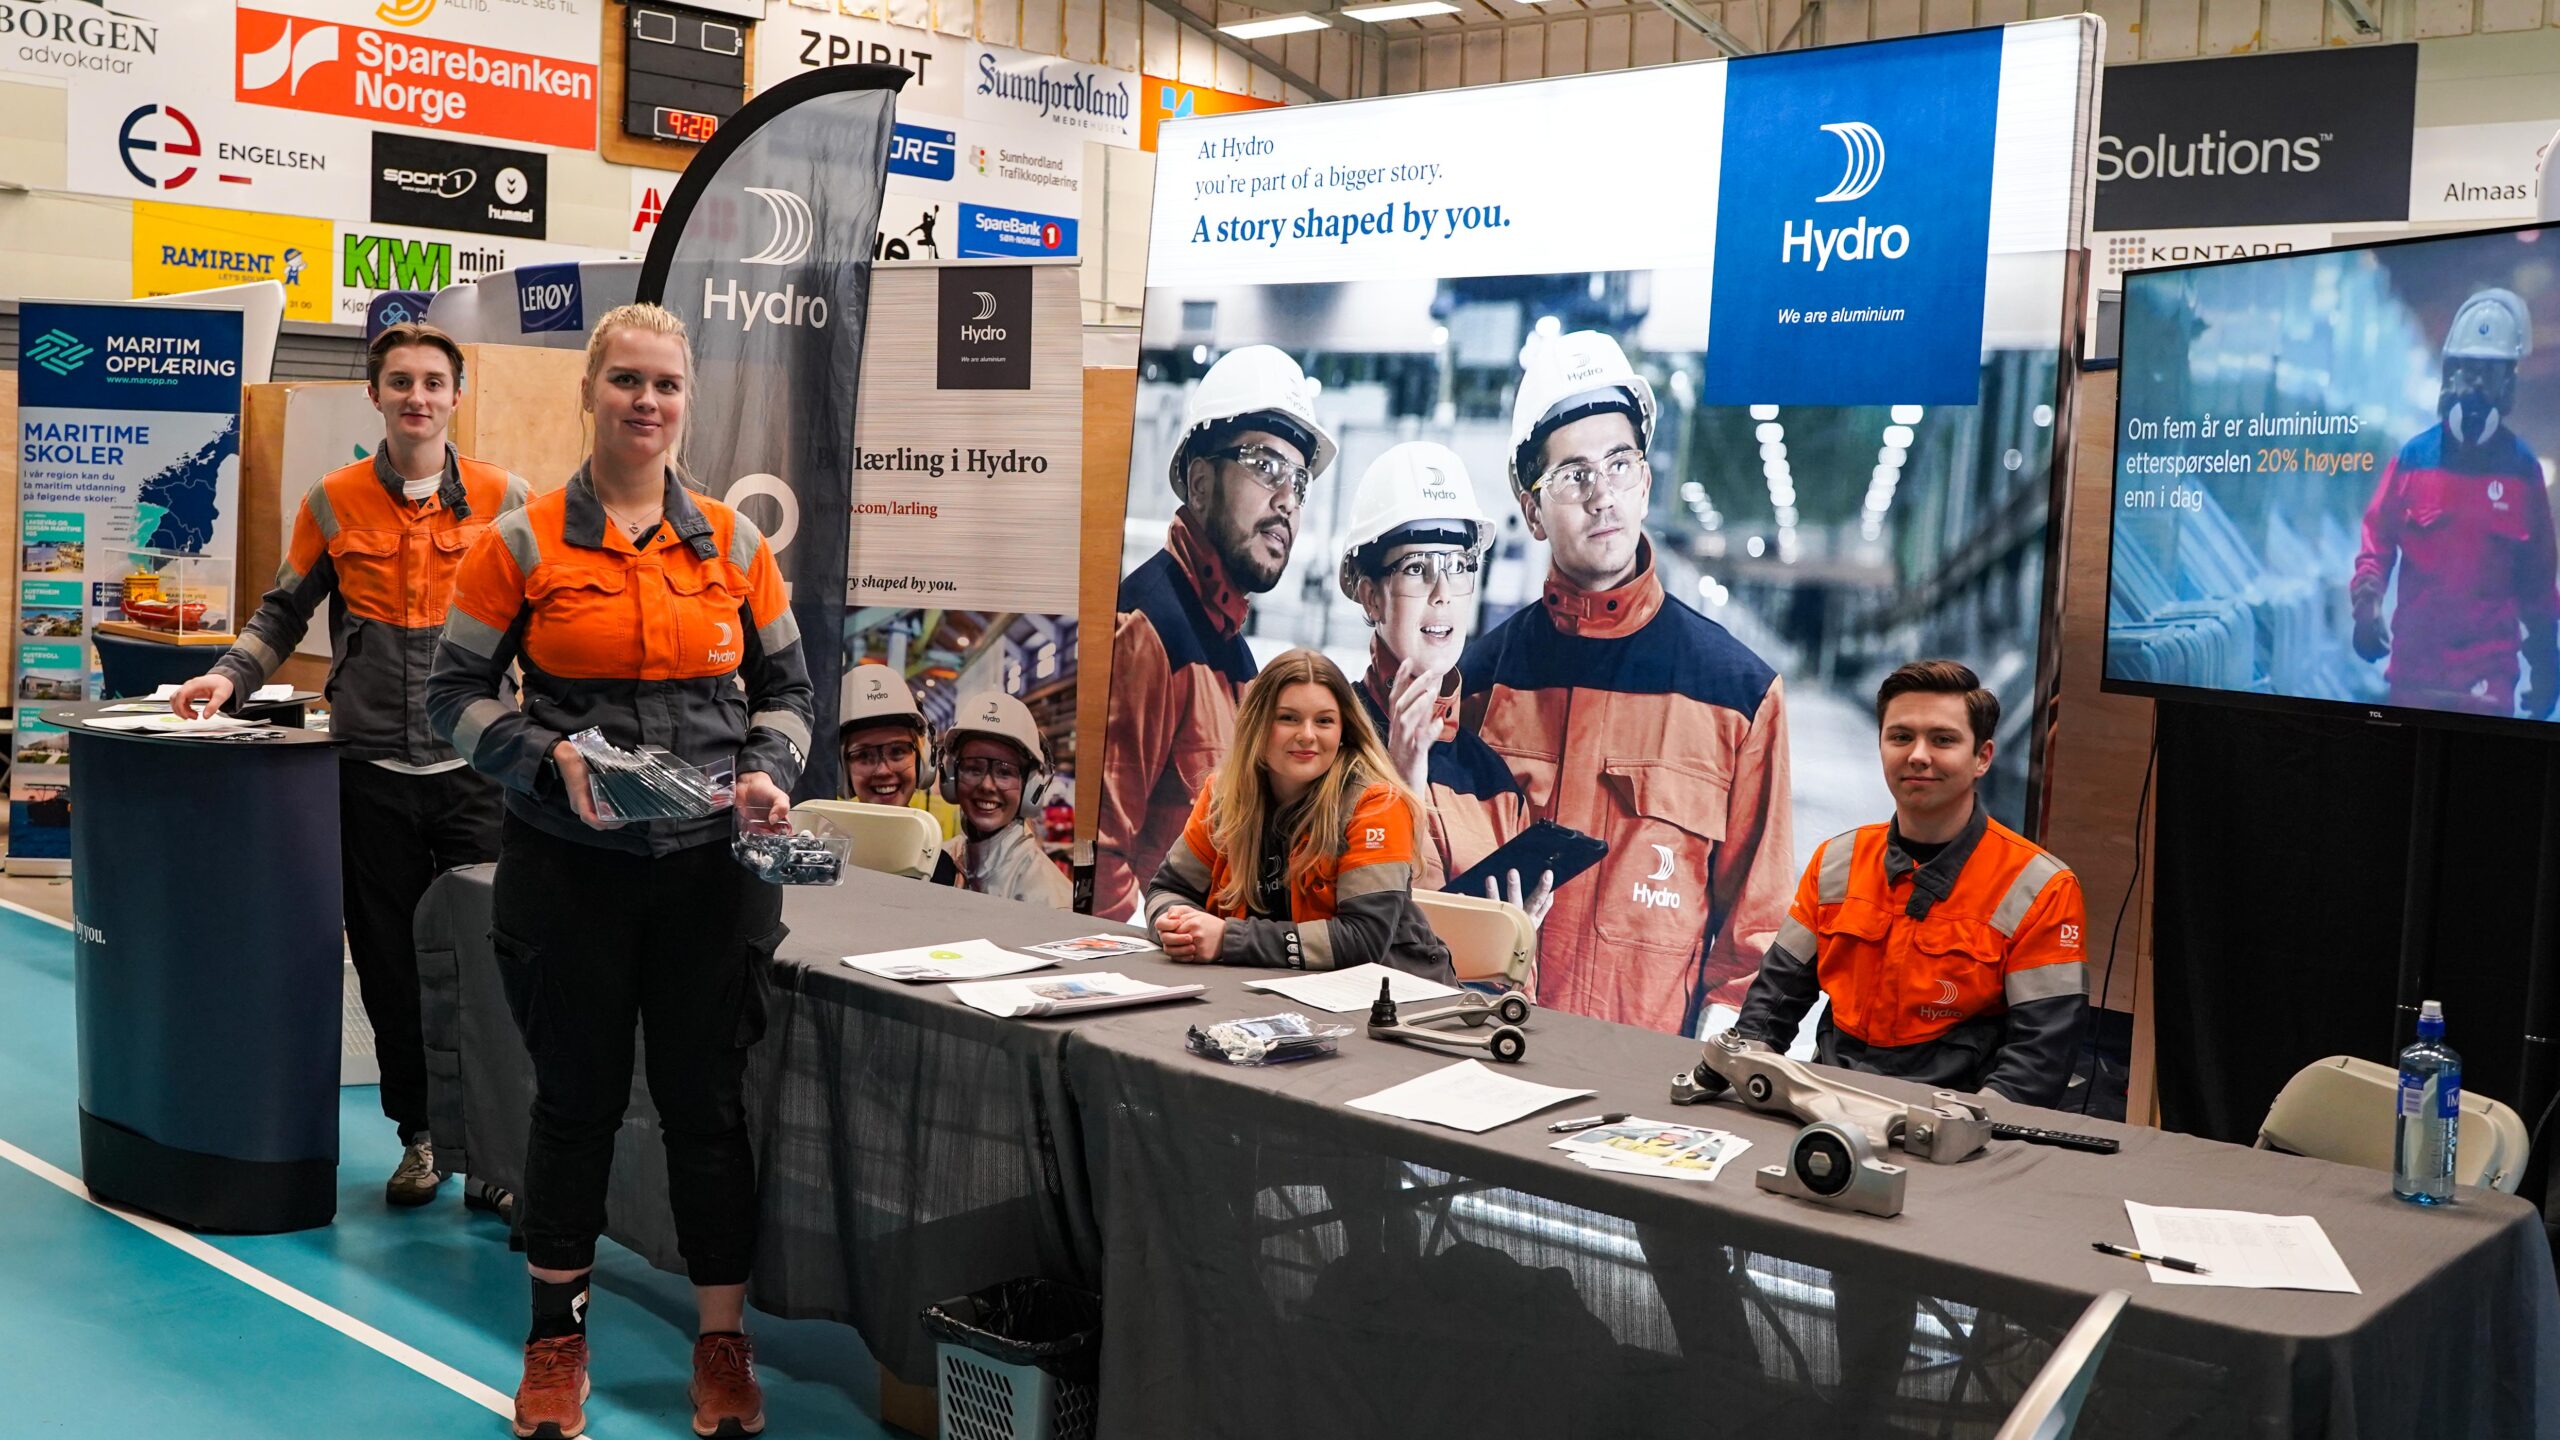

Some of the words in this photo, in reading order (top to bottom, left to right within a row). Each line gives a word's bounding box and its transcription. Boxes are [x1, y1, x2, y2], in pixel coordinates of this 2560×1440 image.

[19, 45, 134, 75] advokatar
[356, 30, 592, 100] Sparebanken
[355, 70, 466, 124] Norge
[977, 53, 1129, 120] Sunnhordland
[669, 112, 716, 141] 9:28
[219, 142, 326, 171] ENGELSEN
[1198, 139, 1217, 160] At
[1222, 135, 1275, 163] Hydro
[1000, 150, 1063, 170] Sunnhordland
[383, 168, 447, 186] sport
[1000, 166, 1078, 191] Trafikkopplæring
[1250, 171, 1286, 198] part
[1291, 167, 1312, 190] of
[1314, 172, 1324, 188] a
[1330, 166, 1386, 191] bigger
[1390, 161, 1442, 186] story.
[2443, 182, 2527, 202] Almaas
[488, 204, 534, 223] hummel
[975, 213, 1041, 236] SpareBank
[1192, 215, 1211, 243] A
[1216, 212, 1287, 248] story
[1293, 202, 1394, 245] shaped
[1403, 201, 1439, 241] by
[1444, 203, 1511, 239] you.
[1782, 216, 1910, 272] Hydro
[162, 245, 274, 274] RAMIRENT
[343, 233, 452, 292] KIWI
[459, 247, 504, 272] mini
[522, 283, 574, 312] LERØY
[703, 278, 828, 331] Hydro
[1778, 308, 1800, 324] We
[1804, 310, 1827, 323] are
[1831, 306, 1905, 323] aluminium
[961, 325, 1007, 344] Hydro
[107, 336, 200, 355] MARITIM
[106, 355, 236, 376] OPPLÆRING
[106, 375, 179, 387] www.maropp.no
[25, 423, 149, 444] MARITIME
[2128, 417, 2158, 441] Om
[2163, 415, 2196, 439] fem
[2201, 413, 2220, 438] år
[2225, 419, 2240, 438] er
[2248, 411, 2367, 438] aluminiums-
[24, 444, 124, 465] SKOLER
[854, 446, 945, 478] lærling
[952, 448, 960, 471] i
[967, 449, 1048, 479] Hydro
[2126, 449, 2251, 478] etterspørselen
[2257, 448, 2298, 474] 20%
[2304, 448, 2374, 479] høyere
[24, 471, 27, 479] I
[29, 470, 45, 479] vår
[46, 471, 79, 481] region
[82, 471, 99, 480] kan
[101, 471, 115, 480] du
[24, 492, 34, 502] på
[37, 492, 81, 502] følgende
[84, 493, 117, 503] skoler:
[35, 482, 73, 490] maritim
[76, 483, 126, 493] utdanning
[1422, 488, 1457, 501] Hydro
[2124, 490, 2155, 508] enn
[2160, 486, 2165, 508] i
[2170, 486, 2203, 512] dag
[862, 575, 908, 591] shaped
[912, 576, 926, 592] by
[928, 579, 957, 593] you.
[708, 649, 736, 664] Hydro
[867, 692, 889, 701] Hydro
[982, 714, 1000, 724] Hydro
[1366, 828, 1385, 842] D3
[1632, 882, 1681, 909] Hydro
[84, 925, 106, 945] you.
[2061, 924, 2079, 940] D3
[1919, 1005, 1962, 1021] Hydro
